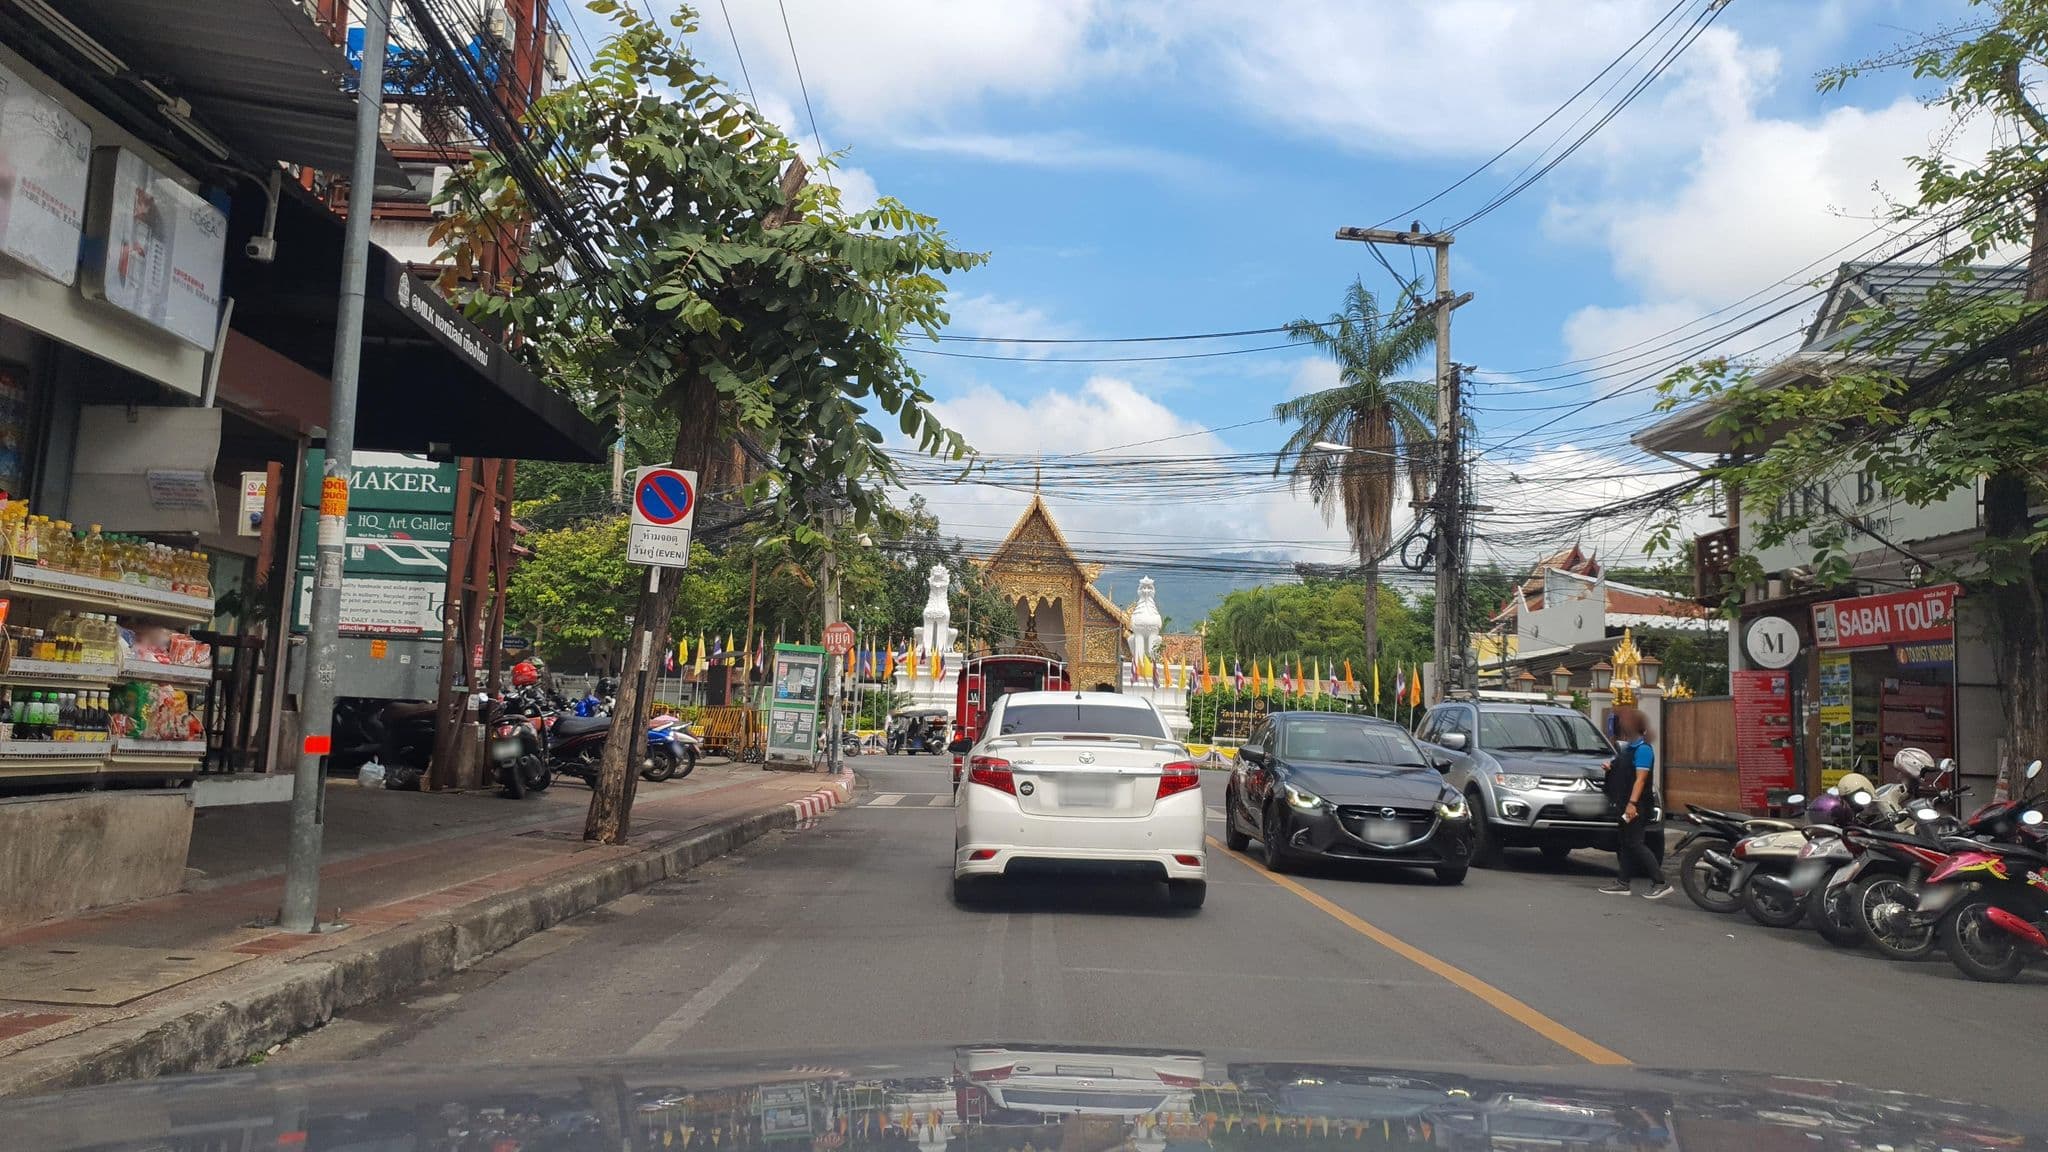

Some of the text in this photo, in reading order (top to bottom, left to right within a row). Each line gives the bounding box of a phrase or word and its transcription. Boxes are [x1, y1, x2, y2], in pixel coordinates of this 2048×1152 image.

[358, 514, 385, 531] HQ
[388, 516, 407, 529] Art
[410, 517, 451, 531] Galler
[655, 549, 685, 560] (EVEN)
[1839, 599, 1946, 637] SABAI TOUR
[390, 626, 420, 634] Souvenir
[1763, 632, 1785, 654] M
